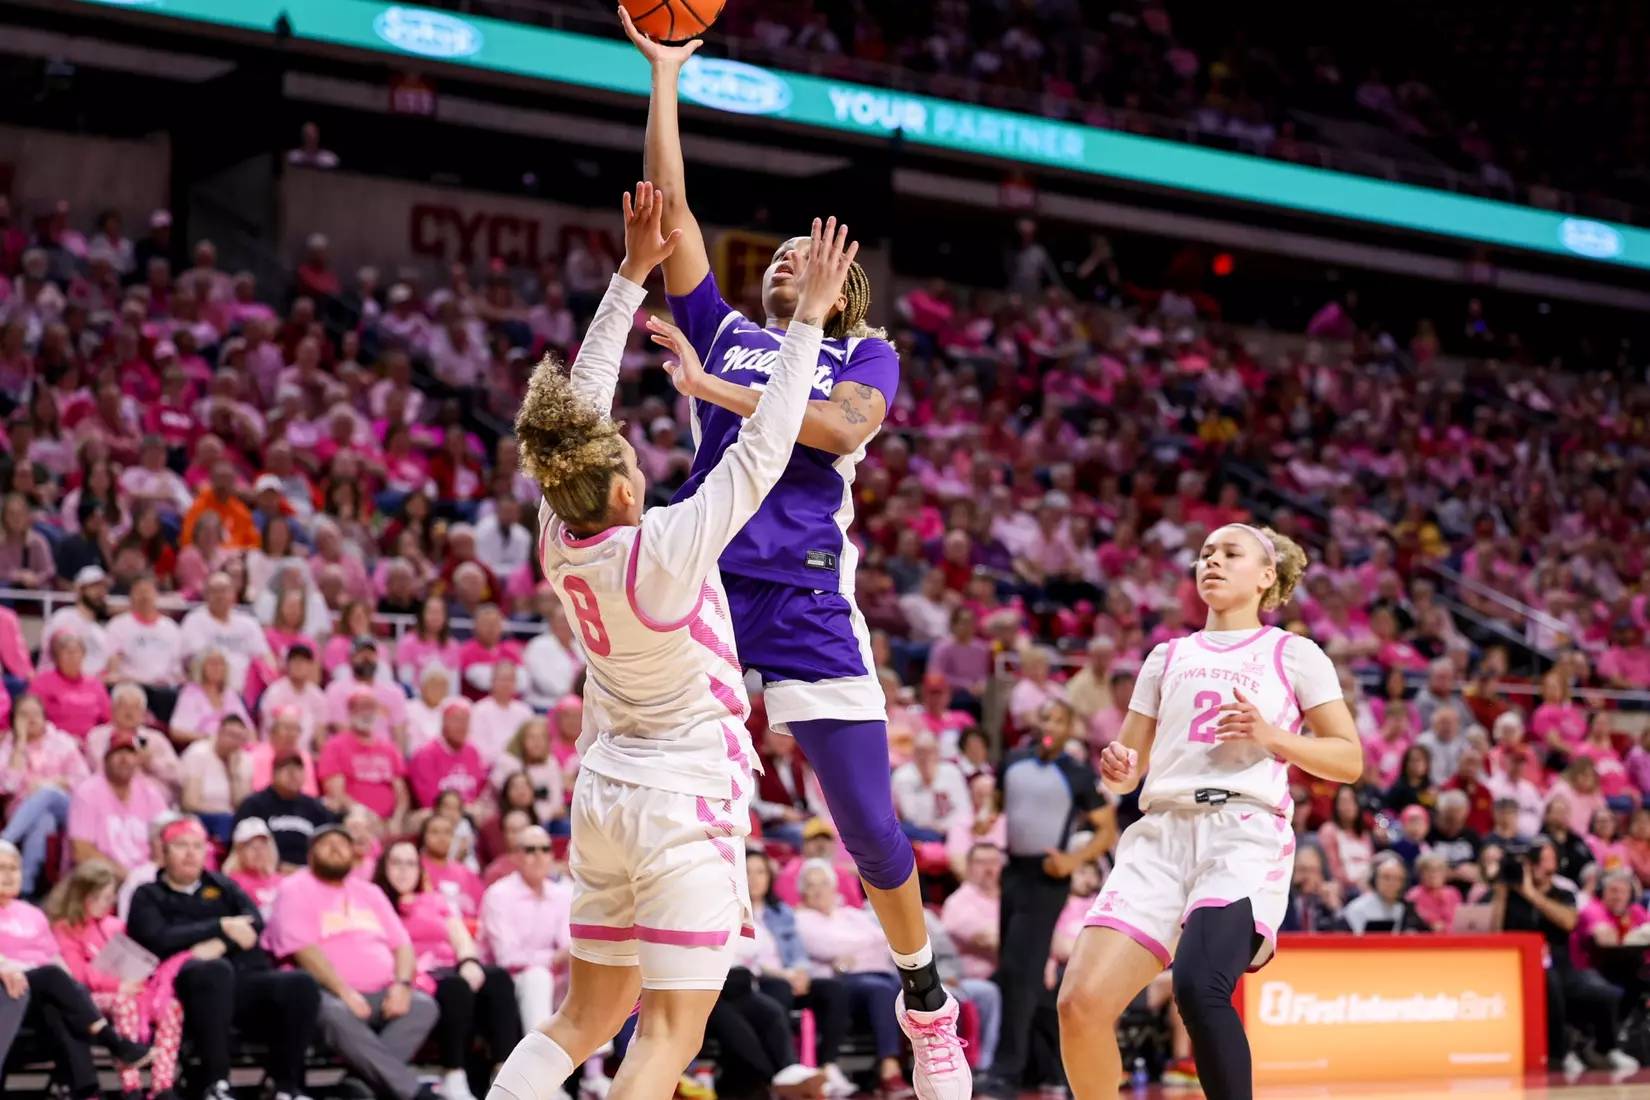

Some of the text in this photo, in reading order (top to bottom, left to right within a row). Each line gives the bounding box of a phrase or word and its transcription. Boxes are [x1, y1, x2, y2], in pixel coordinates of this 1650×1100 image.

[829, 86, 1085, 162] YOUR PARTNER
[563, 574, 611, 657] 8
[1210, 668, 1260, 694] STATE
[1188, 690, 1222, 744] 2
